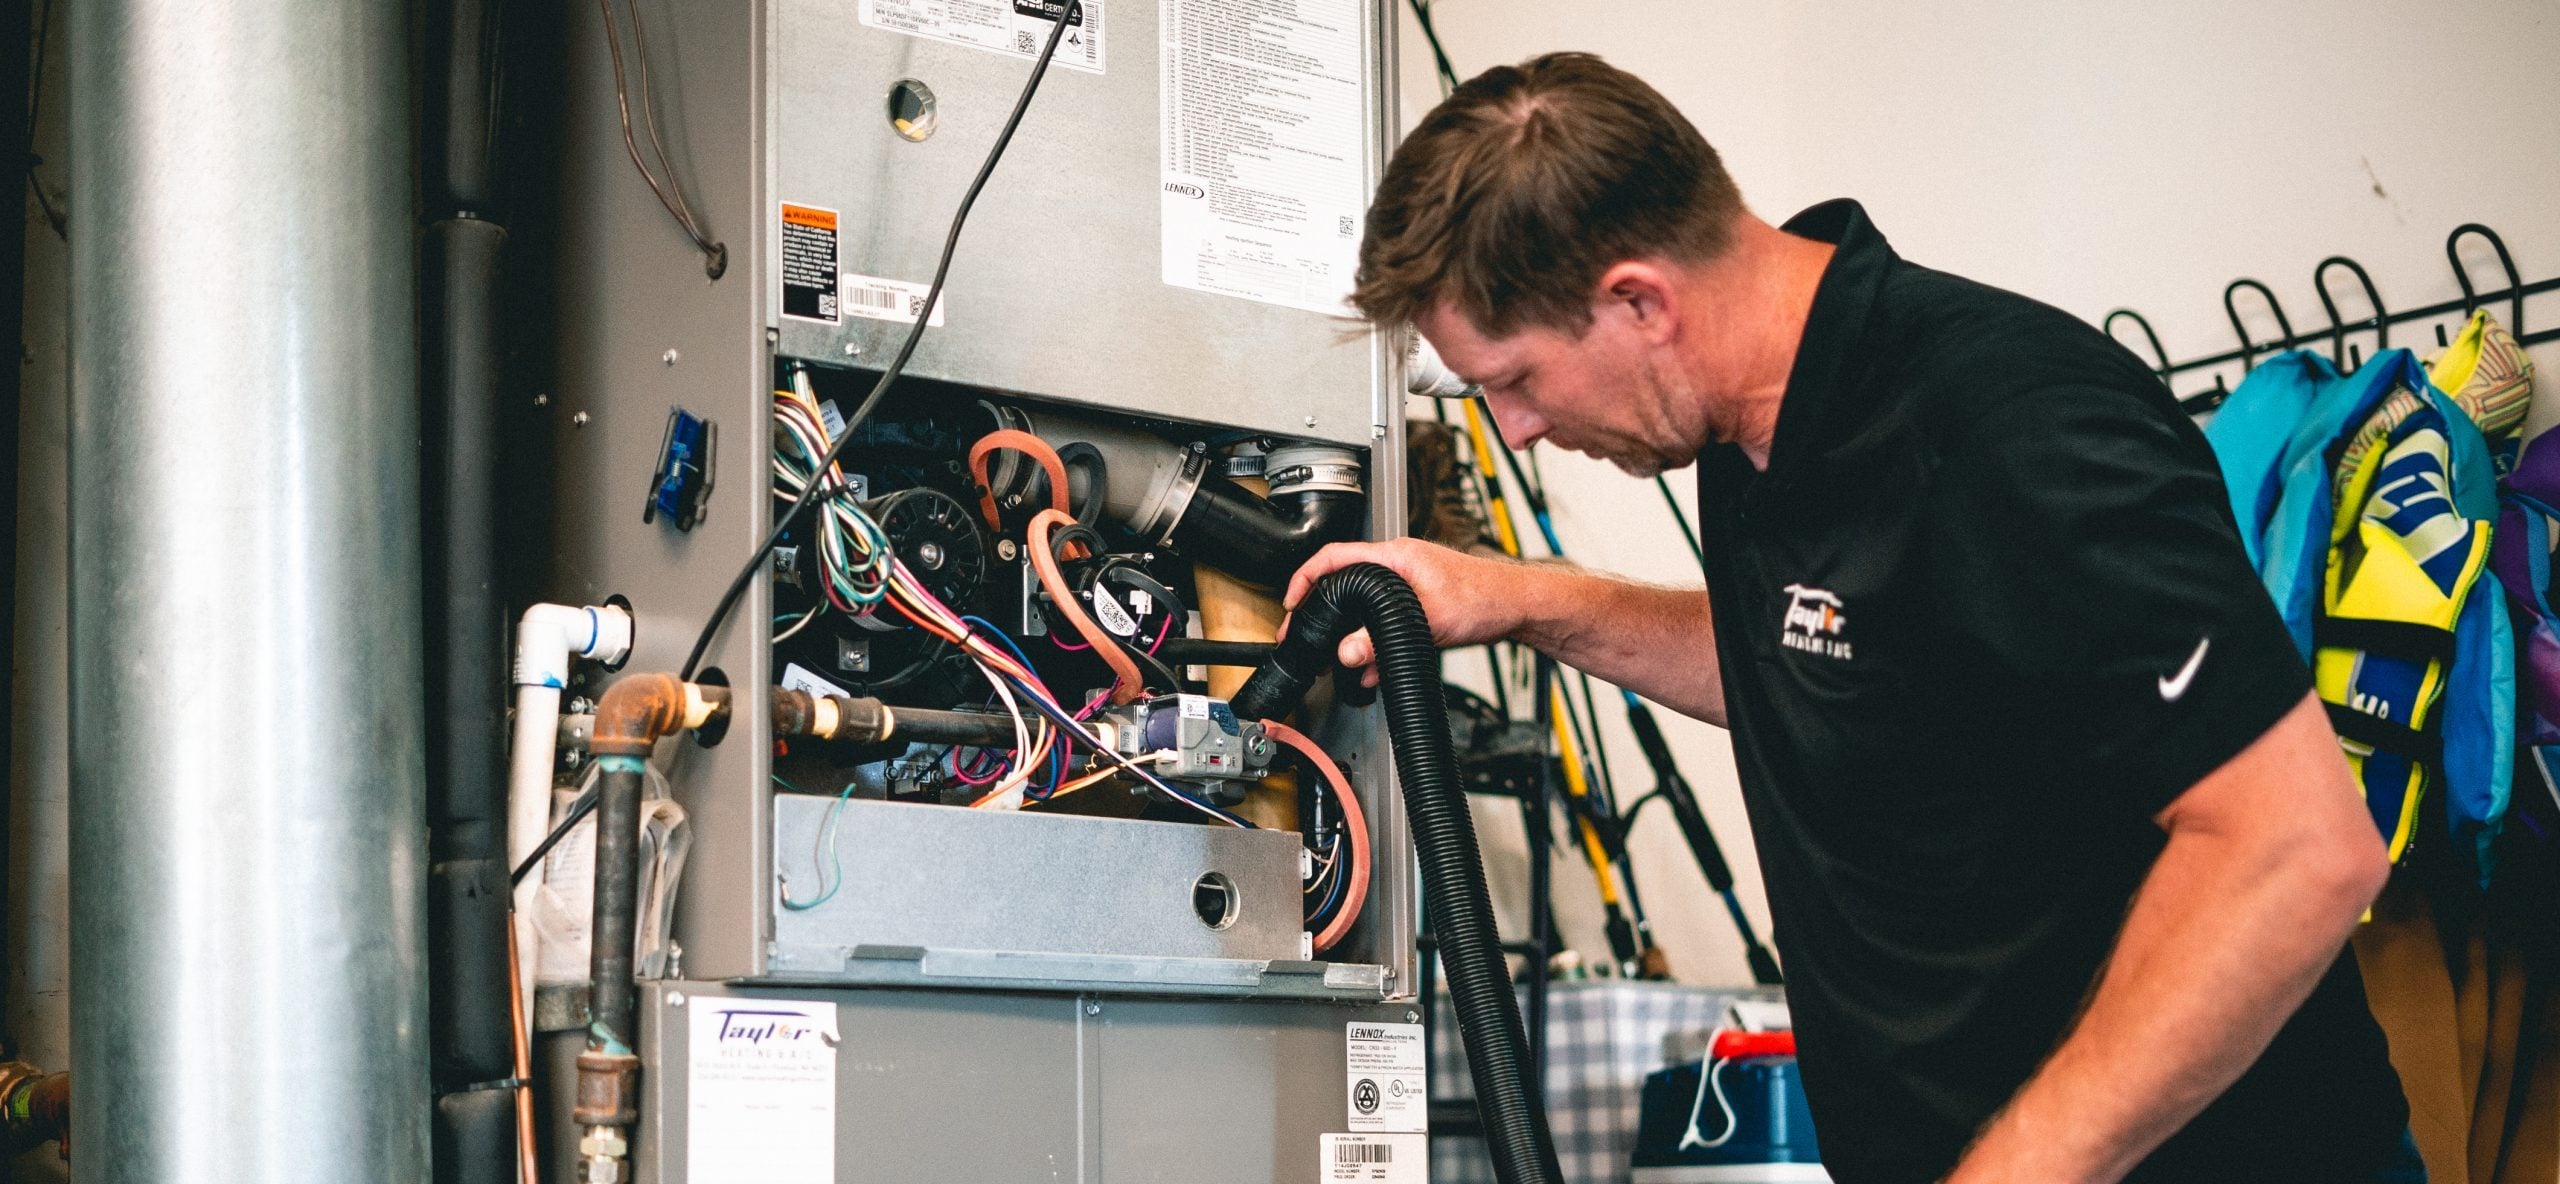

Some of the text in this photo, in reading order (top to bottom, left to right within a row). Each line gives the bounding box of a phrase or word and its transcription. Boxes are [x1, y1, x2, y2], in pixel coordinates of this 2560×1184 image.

[1165, 182, 1196, 197] LENNOX
[793, 211, 835, 225] WARNING
[1783, 582, 1846, 637] Taylor
[712, 1010, 811, 1044] Taylor
[1350, 1028, 1384, 1039] LENNOX
